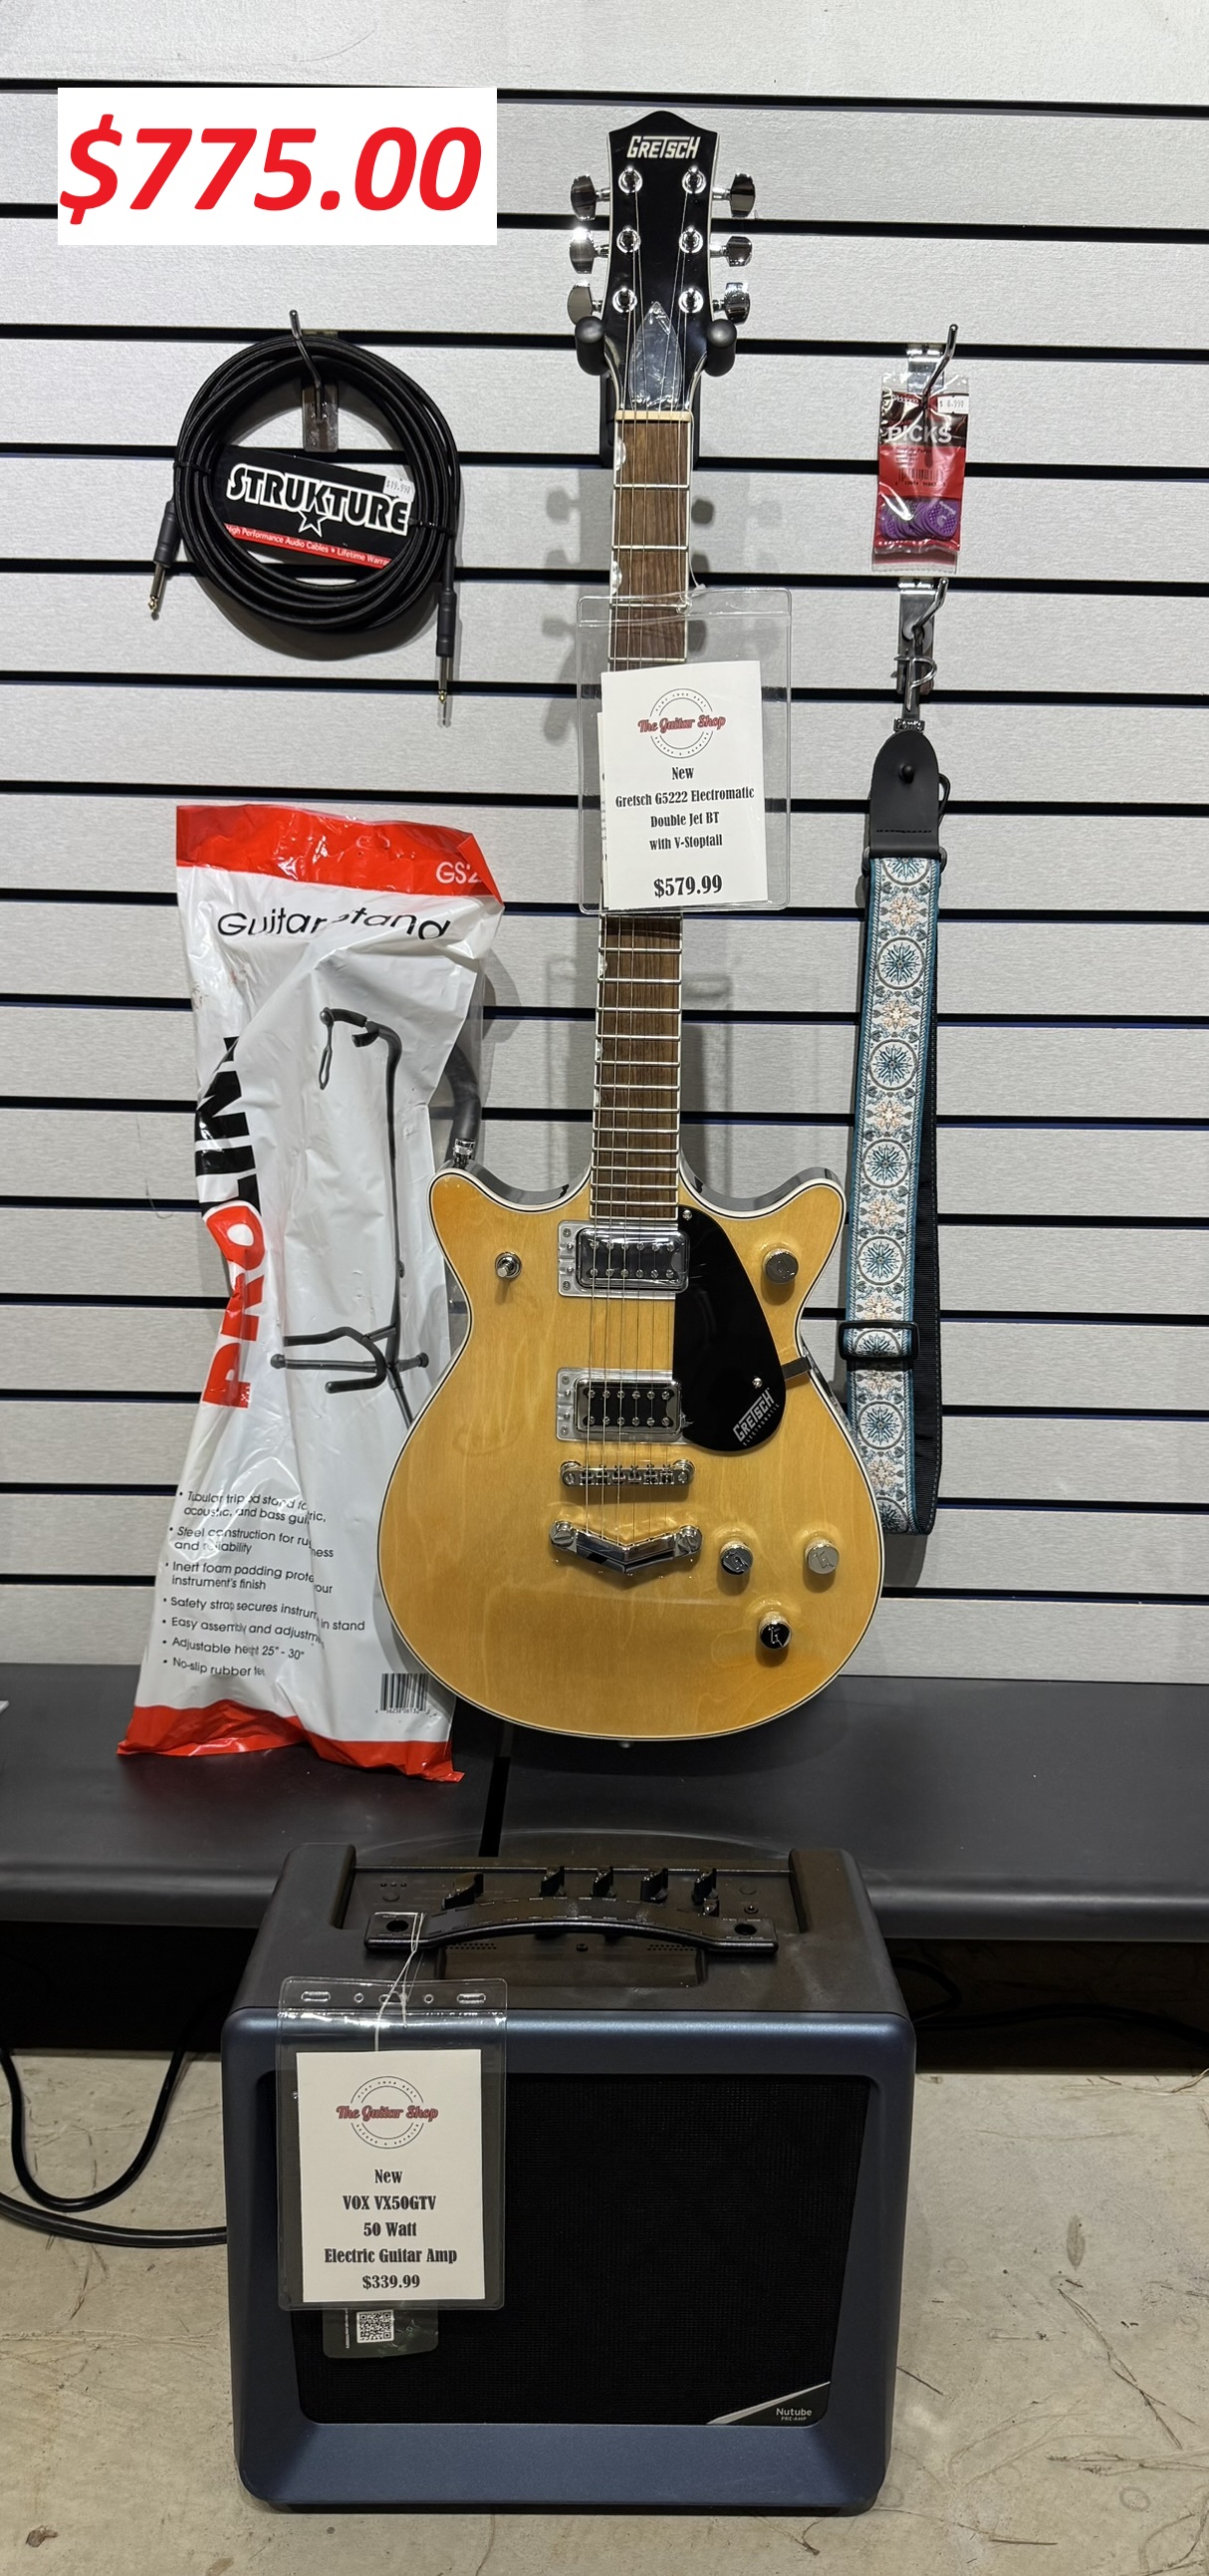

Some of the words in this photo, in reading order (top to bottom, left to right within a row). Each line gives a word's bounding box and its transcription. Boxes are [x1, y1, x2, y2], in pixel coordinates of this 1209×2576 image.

[626, 135, 701, 158] GRETSCH
[887, 425, 952, 443] PICKS
[226, 463, 412, 536] STRUKTURE
[241, 526, 285, 544] Performance
[285, 536, 306, 549] Audio
[307, 540, 329, 553] Cables
[337, 548, 365, 562] Lifetime
[637, 719, 658, 733] The
[659, 717, 695, 734] Guitar
[697, 714, 726, 730] Shop
[671, 767, 694, 780] New
[615, 793, 651, 808] Gretsch
[655, 791, 688, 805] G5222
[691, 787, 755, 802] Electromatic
[650, 814, 686, 828] Double
[689, 813, 703, 827] Jet
[706, 812, 720, 824] BT
[649, 838, 671, 850] with
[674, 834, 723, 849] V-Stoptail
[653, 875, 723, 898] $579.99
[217, 907, 328, 935] Guitar
[733, 1390, 775, 1442] GRETSCH
[187, 1491, 223, 1503] Tubular
[260, 1508, 286, 1521] bass
[177, 1526, 205, 1537] Steel
[207, 1528, 276, 1541] construction
[279, 1532, 294, 1544] for
[174, 1541, 199, 1551] and
[172, 1561, 199, 1572] Inert
[202, 1562, 232, 1573] foam
[234, 1565, 282, 1580] padding
[171, 1575, 237, 1588] instrument's
[239, 1578, 266, 1590] finish
[170, 1596, 207, 1611] Safety
[210, 1600, 235, 1612] strap
[236, 1602, 278, 1613] secures
[333, 1620, 365, 1631] stand
[171, 1617, 197, 1631] Easy
[249, 1624, 272, 1635] and
[172, 1637, 231, 1655] Adjustable
[172, 1657, 207, 1674] No-slip
[210, 1663, 251, 1676] rubber
[336, 2105, 361, 2119] The
[362, 2104, 403, 2122] Guitar
[405, 2104, 438, 2123] Shop
[374, 2169, 402, 2184] New
[343, 2195, 370, 2210] VOX
[373, 2195, 436, 2210] VX50GTV
[363, 2221, 381, 2236] 50
[385, 2221, 417, 2237] Watt
[324, 2248, 375, 2263] Electric
[378, 2248, 422, 2263] Guitar
[426, 2248, 458, 2264] Amp
[362, 2274, 420, 2290] $339.99
[776, 2408, 813, 2417] Nutube
